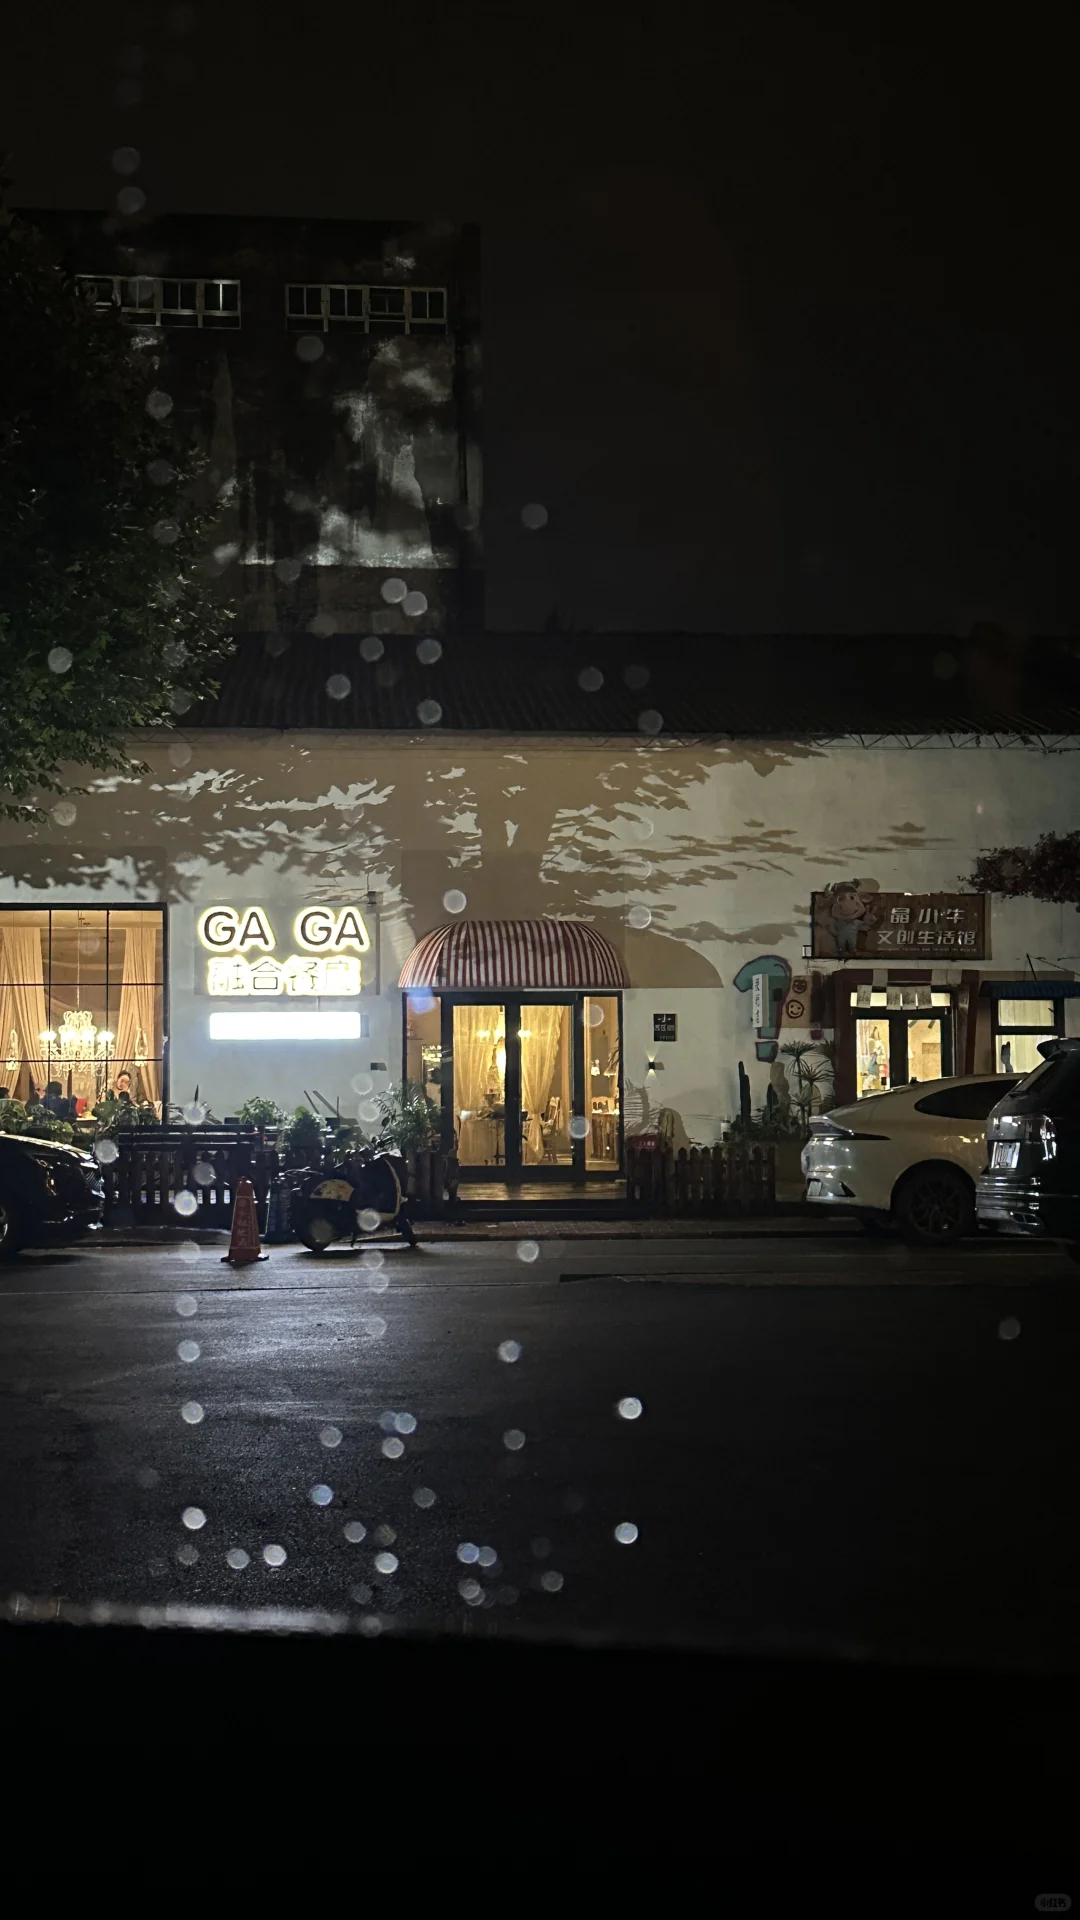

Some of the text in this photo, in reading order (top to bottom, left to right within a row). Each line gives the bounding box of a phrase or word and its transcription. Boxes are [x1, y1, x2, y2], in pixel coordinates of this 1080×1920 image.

[202, 909, 366, 949] GA GA
[876, 930, 976, 946] 文创生活馆
